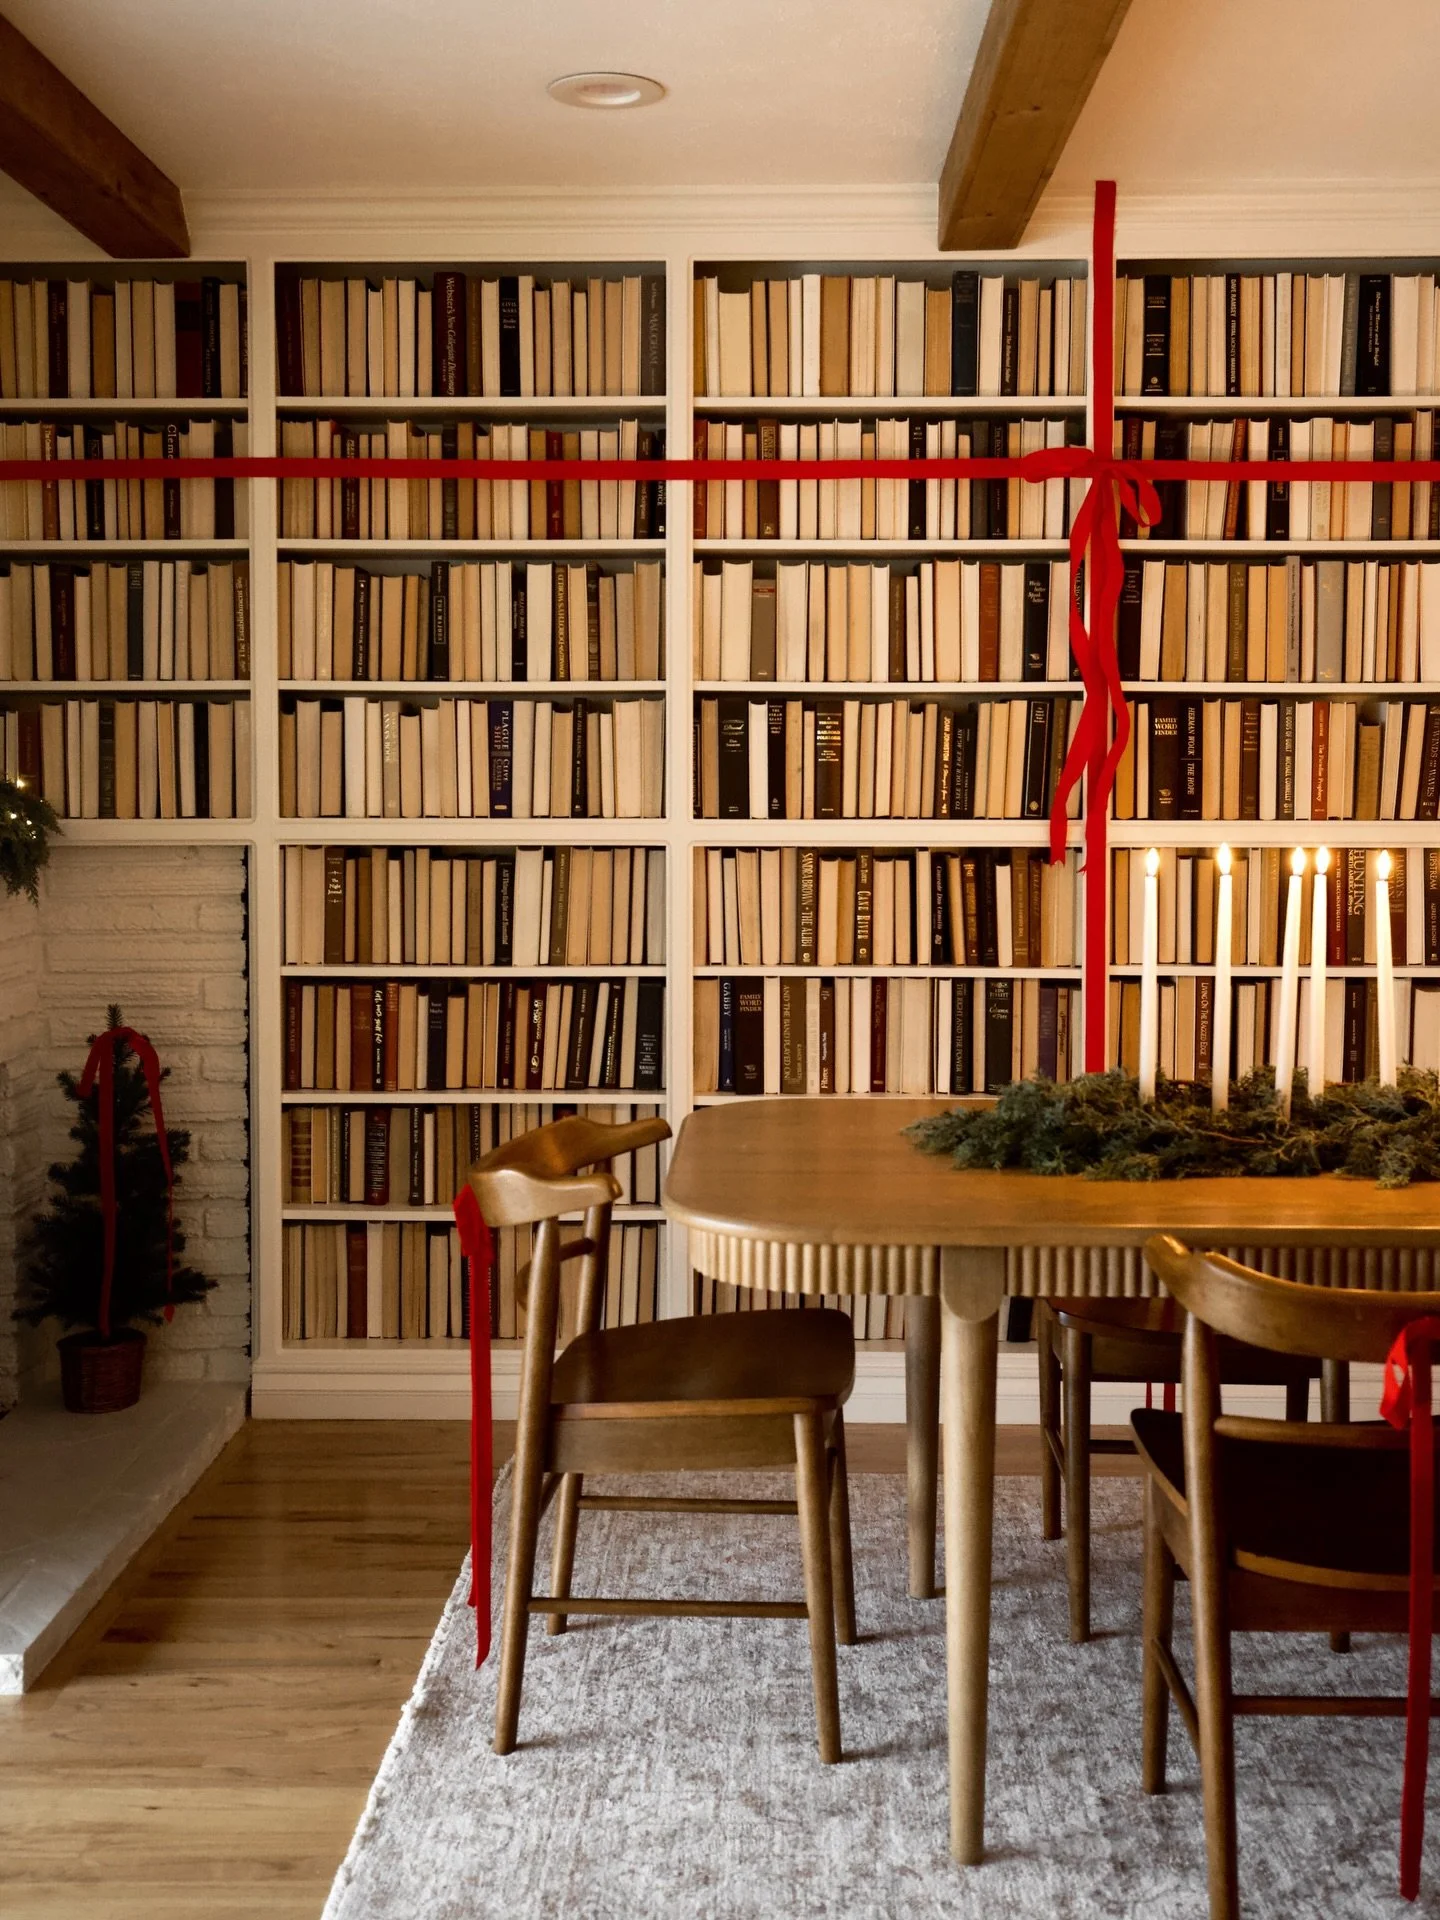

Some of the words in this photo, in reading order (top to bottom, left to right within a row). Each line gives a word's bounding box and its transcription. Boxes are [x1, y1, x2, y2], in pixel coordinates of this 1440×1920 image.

[446, 277, 455, 314] Webster's
[448, 316, 456, 329] New
[446, 330, 456, 361] Collegiate
[649, 313, 659, 365] MAUGHAM
[447, 362, 457, 395] Dictionary
[236, 590, 245, 641] Establishment
[238, 644, 246, 658] The
[1187, 707, 1195, 734] HERMAN
[1285, 706, 1293, 715] THE
[501, 710, 510, 750] PLAGUE
[943, 716, 951, 732] JOAN
[1285, 716, 1293, 730] GODS
[1285, 730, 1292, 738] OF
[1431, 730, 1440, 757] WINDS
[943, 732, 951, 761] JOHNSTON
[1187, 735, 1195, 756] WOUK
[1187, 763, 1195, 776] THE
[1284, 755, 1292, 777] MICHAEL
[1187, 777, 1195, 795] HOPE
[1284, 777, 1292, 802] CONNELLY
[1427, 768, 1437, 797] WAVES
[955, 801, 961, 811] TO
[801, 852, 814, 880] SANDRA
[1395, 854, 1404, 891] HARRY
[1429, 852, 1438, 890] UPSTREAM
[501, 877, 509, 895] Things
[801, 879, 814, 905] BROWN
[1353, 849, 1365, 915] HUNTING
[857, 890, 871, 911] CANE
[801, 911, 813, 926] THE
[856, 915, 871, 940] RIVER
[801, 927, 813, 947] ALIBI
[723, 982, 731, 1017] GABBY
[783, 984, 791, 1002] AND
[956, 984, 964, 996] THE
[1199, 982, 1209, 1000] LIVING
[783, 1003, 791, 1016] THE
[956, 997, 964, 1018] RIGHT
[1200, 999, 1209, 1009] ON
[1200, 1009, 1209, 1020] THE
[783, 1018, 791, 1039] BAND
[956, 1018, 964, 1034] AND
[1199, 1020, 1209, 1041] RAGGED
[783, 1039, 791, 1066] PLAYED
[1200, 1041, 1209, 1056] EDGE
[783, 1066, 791, 1079] ON
